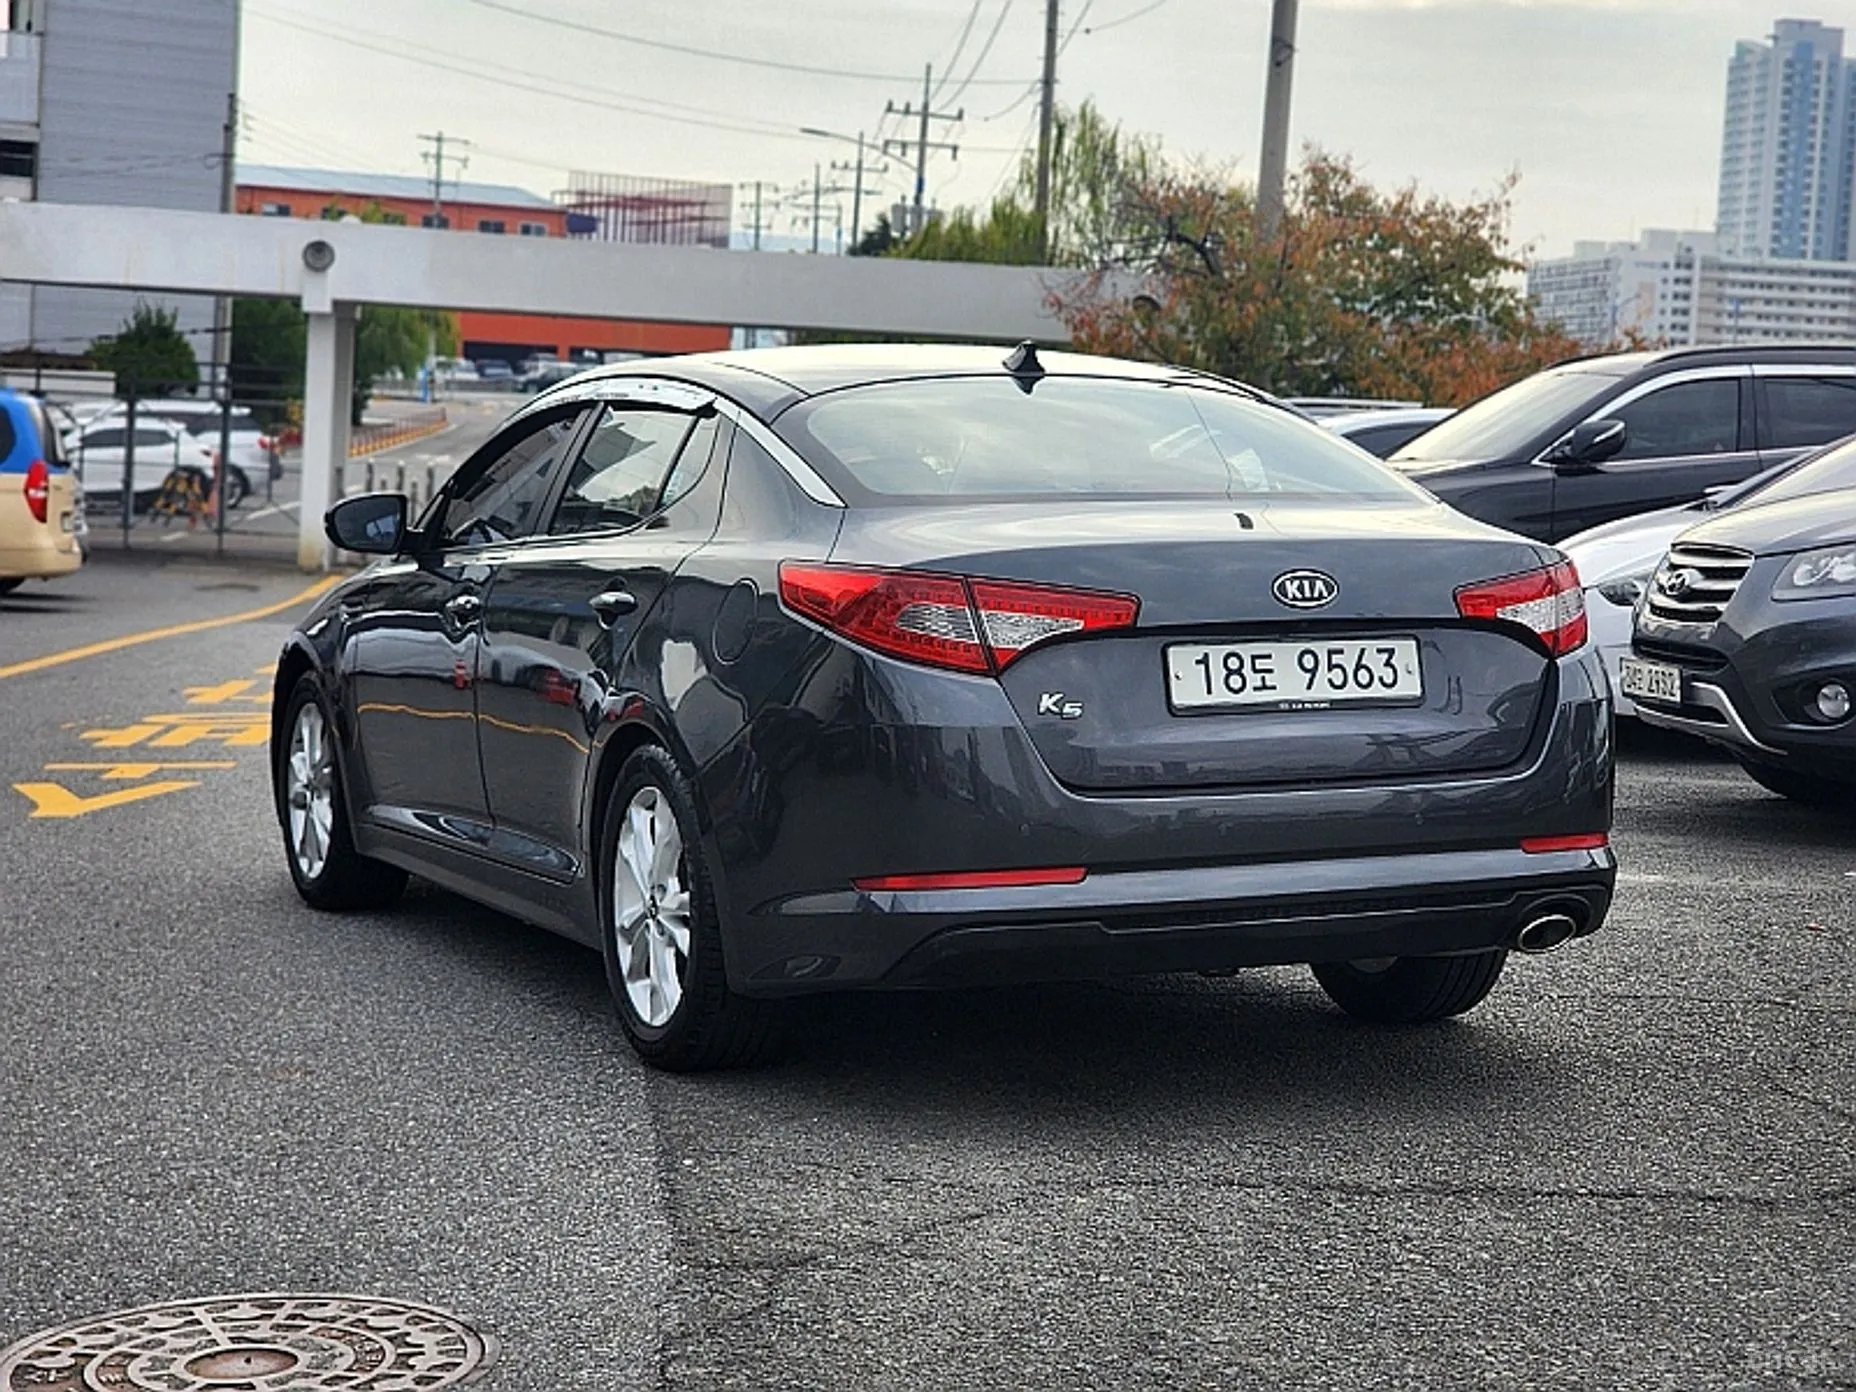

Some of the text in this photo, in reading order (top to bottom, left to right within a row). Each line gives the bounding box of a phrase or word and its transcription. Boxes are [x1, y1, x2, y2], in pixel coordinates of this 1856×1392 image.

[1284, 579, 1328, 599] KIA
[1194, 646, 1399, 695] 18도 9563
[1039, 693, 1083, 719] K5
